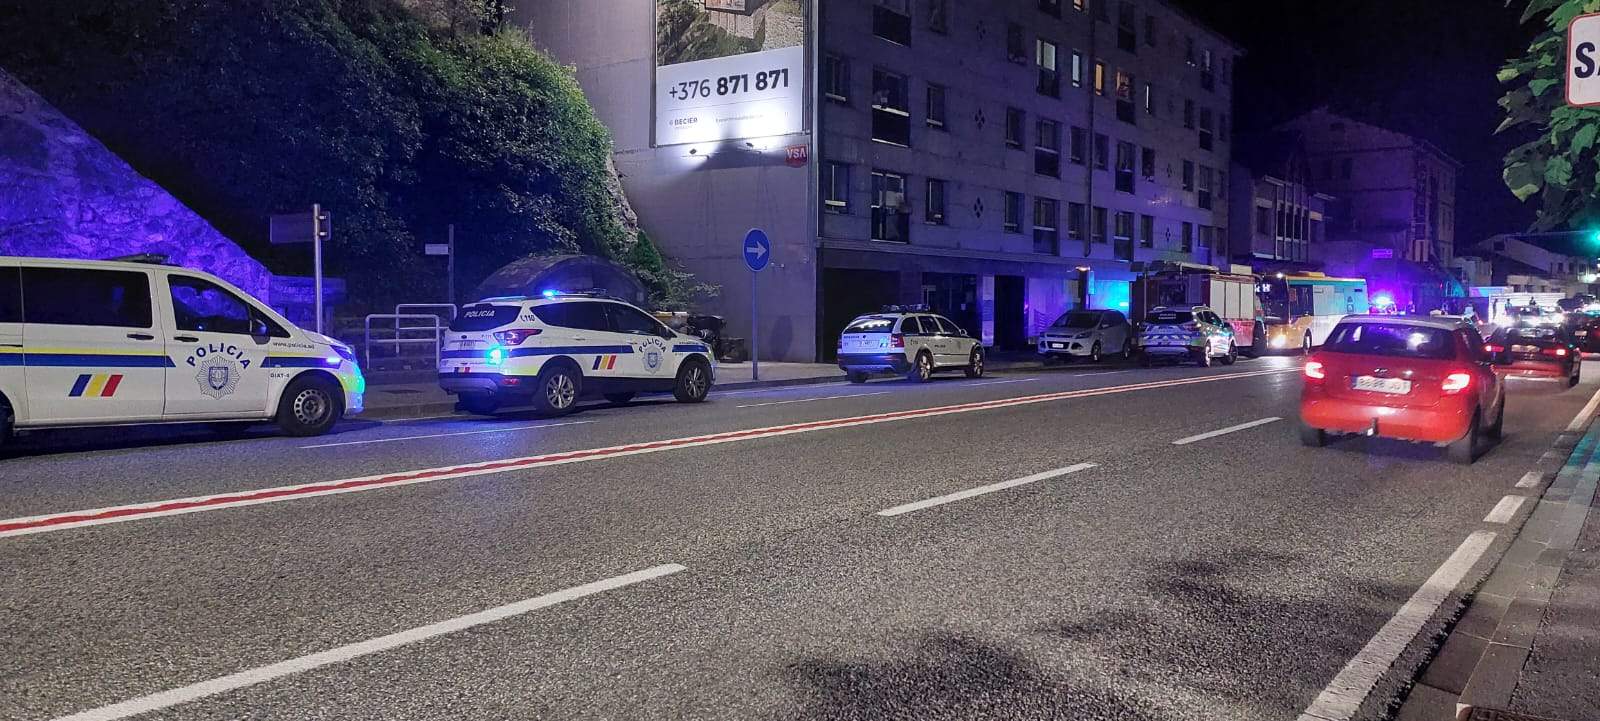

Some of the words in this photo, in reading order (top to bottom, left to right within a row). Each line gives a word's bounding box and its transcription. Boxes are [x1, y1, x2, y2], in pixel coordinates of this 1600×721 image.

[1574, 42, 1600, 78] S
[669, 78, 711, 101] +376
[716, 73, 748, 96] 871
[755, 68, 789, 91] 871
[786, 147, 806, 159] VSA
[464, 310, 495, 318] POLICIA
[186, 342, 251, 370] POLICIA
[638, 337, 667, 353] POLICIA
